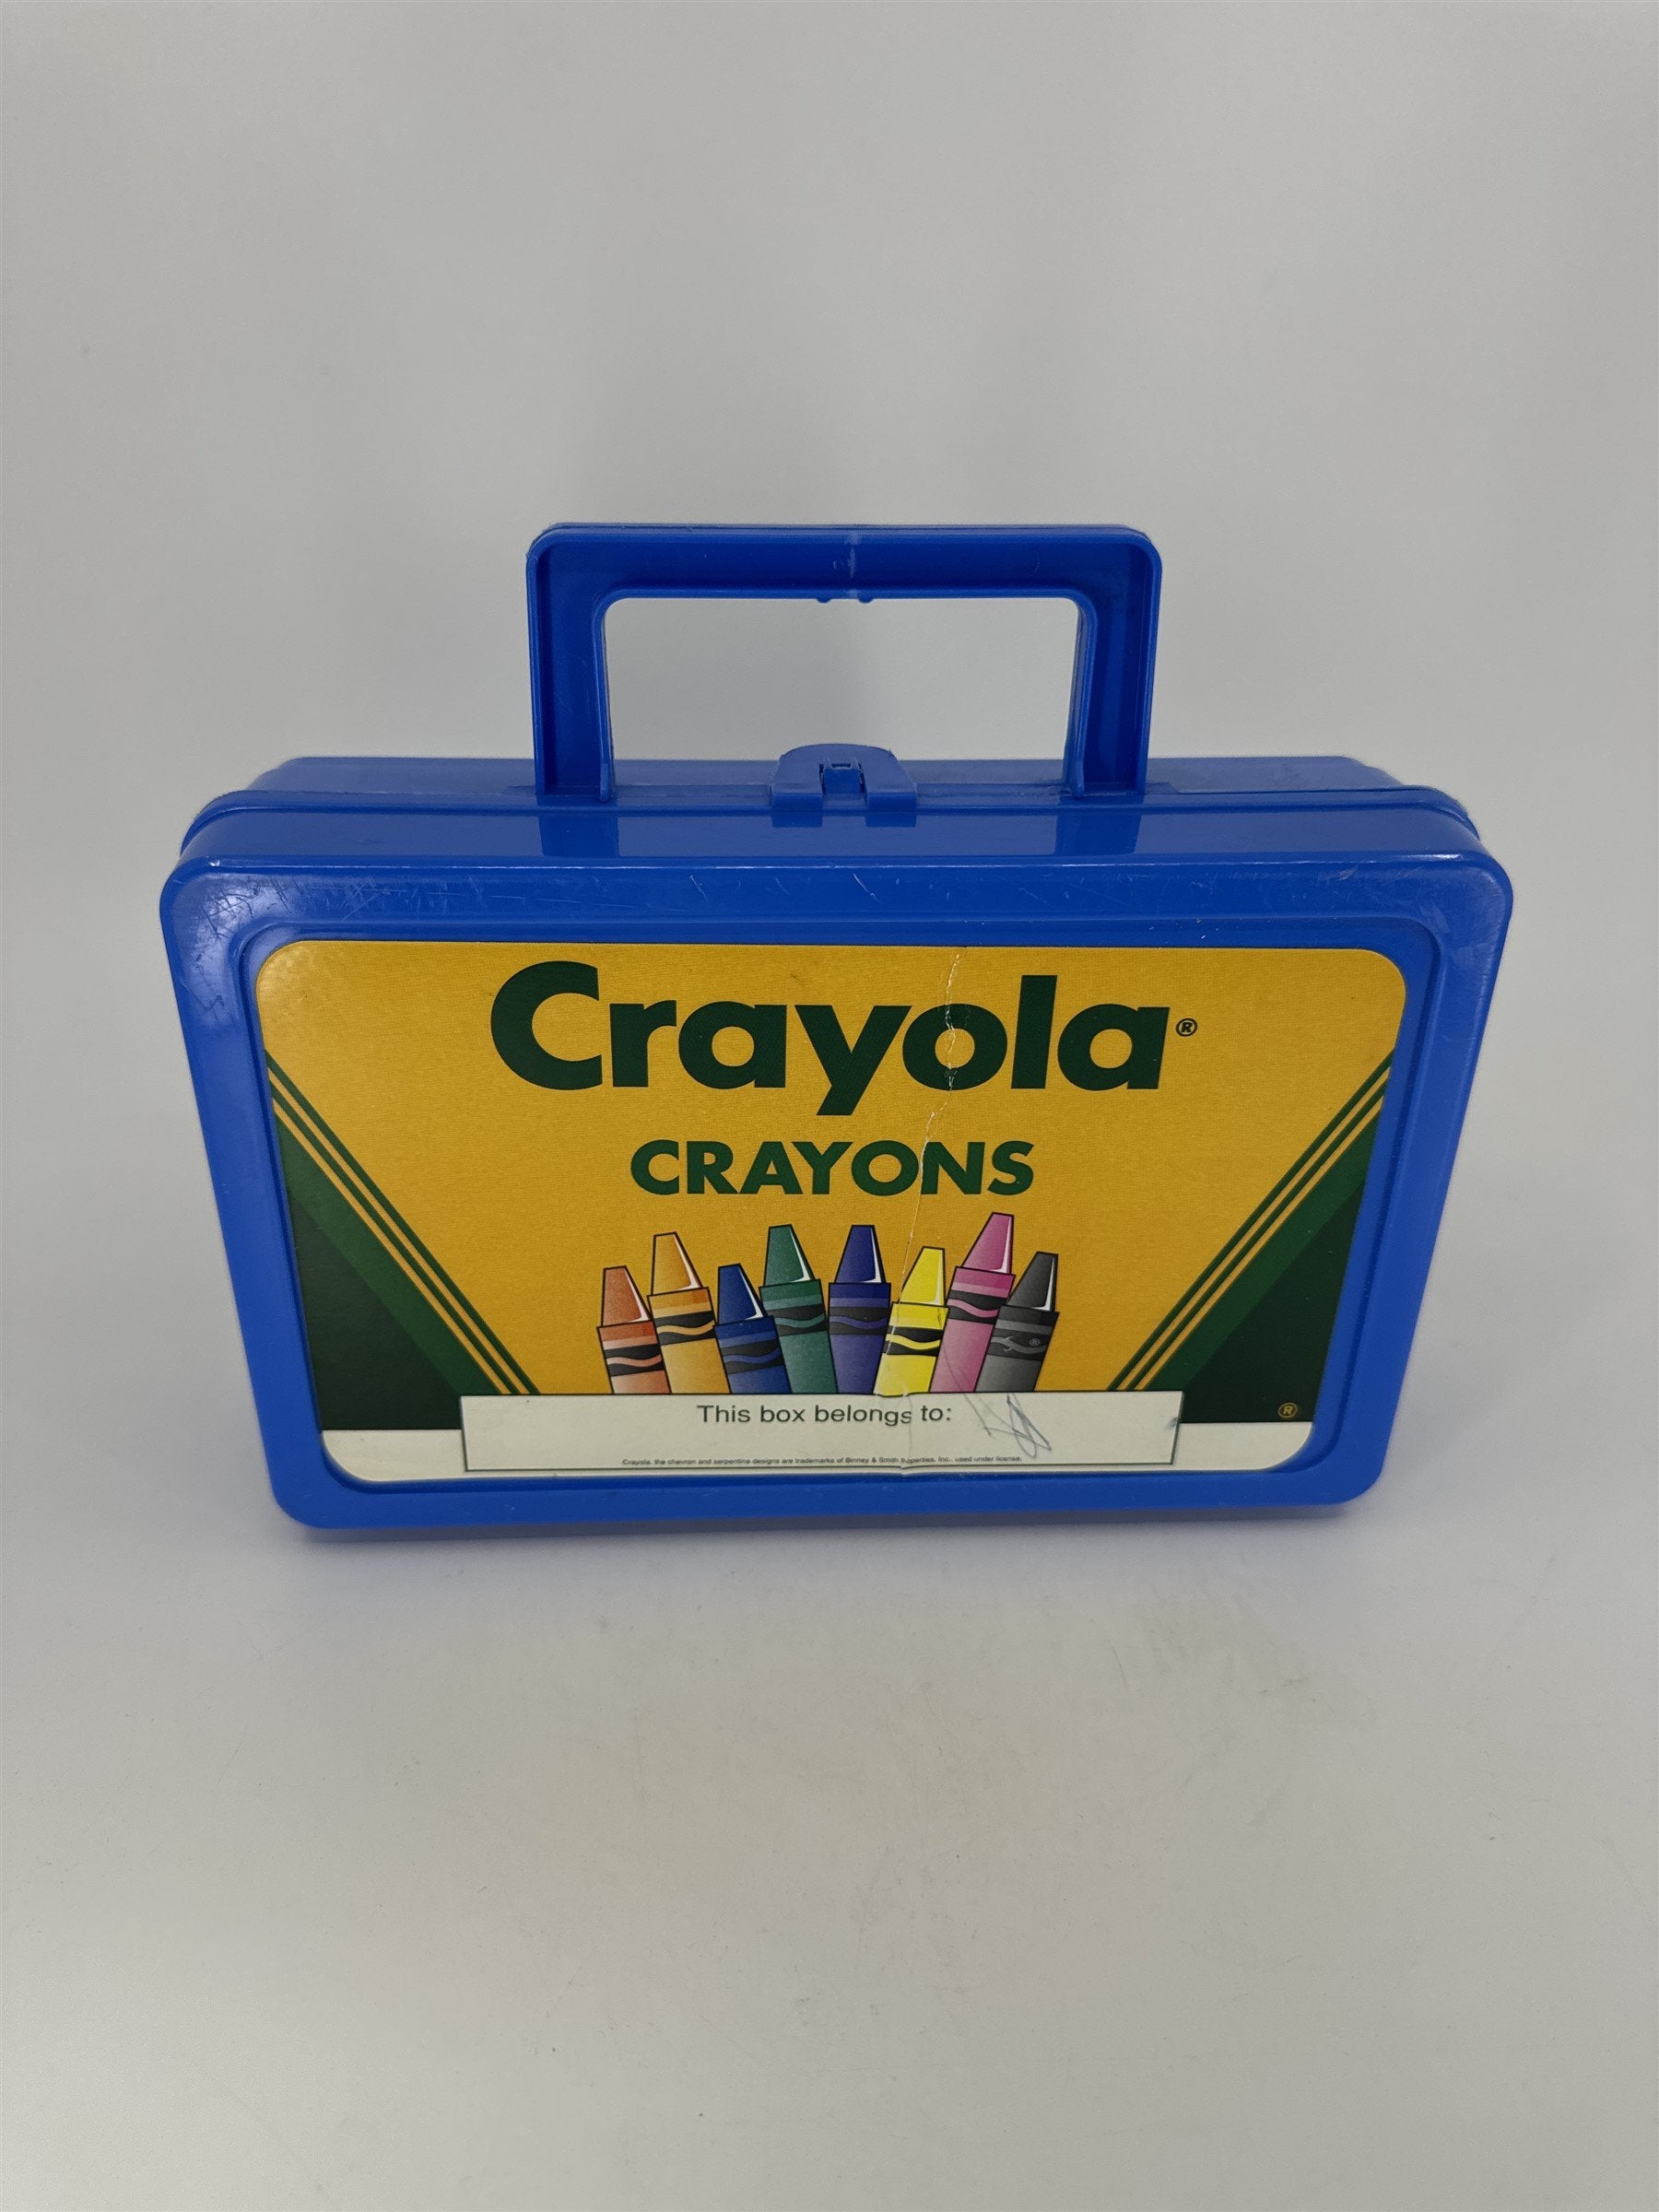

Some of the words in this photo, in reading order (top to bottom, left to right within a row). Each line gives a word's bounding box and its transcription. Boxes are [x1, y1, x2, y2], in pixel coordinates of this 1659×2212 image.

[630, 1139, 1034, 1197] CRAYONS
[697, 1405, 751, 1422] This
[759, 1405, 806, 1422] box
[815, 1405, 912, 1426] belongs
[921, 1405, 952, 1421] to:
[713, 1458, 750, 1466] serpentine
[845, 1456, 869, 1465] Binney
